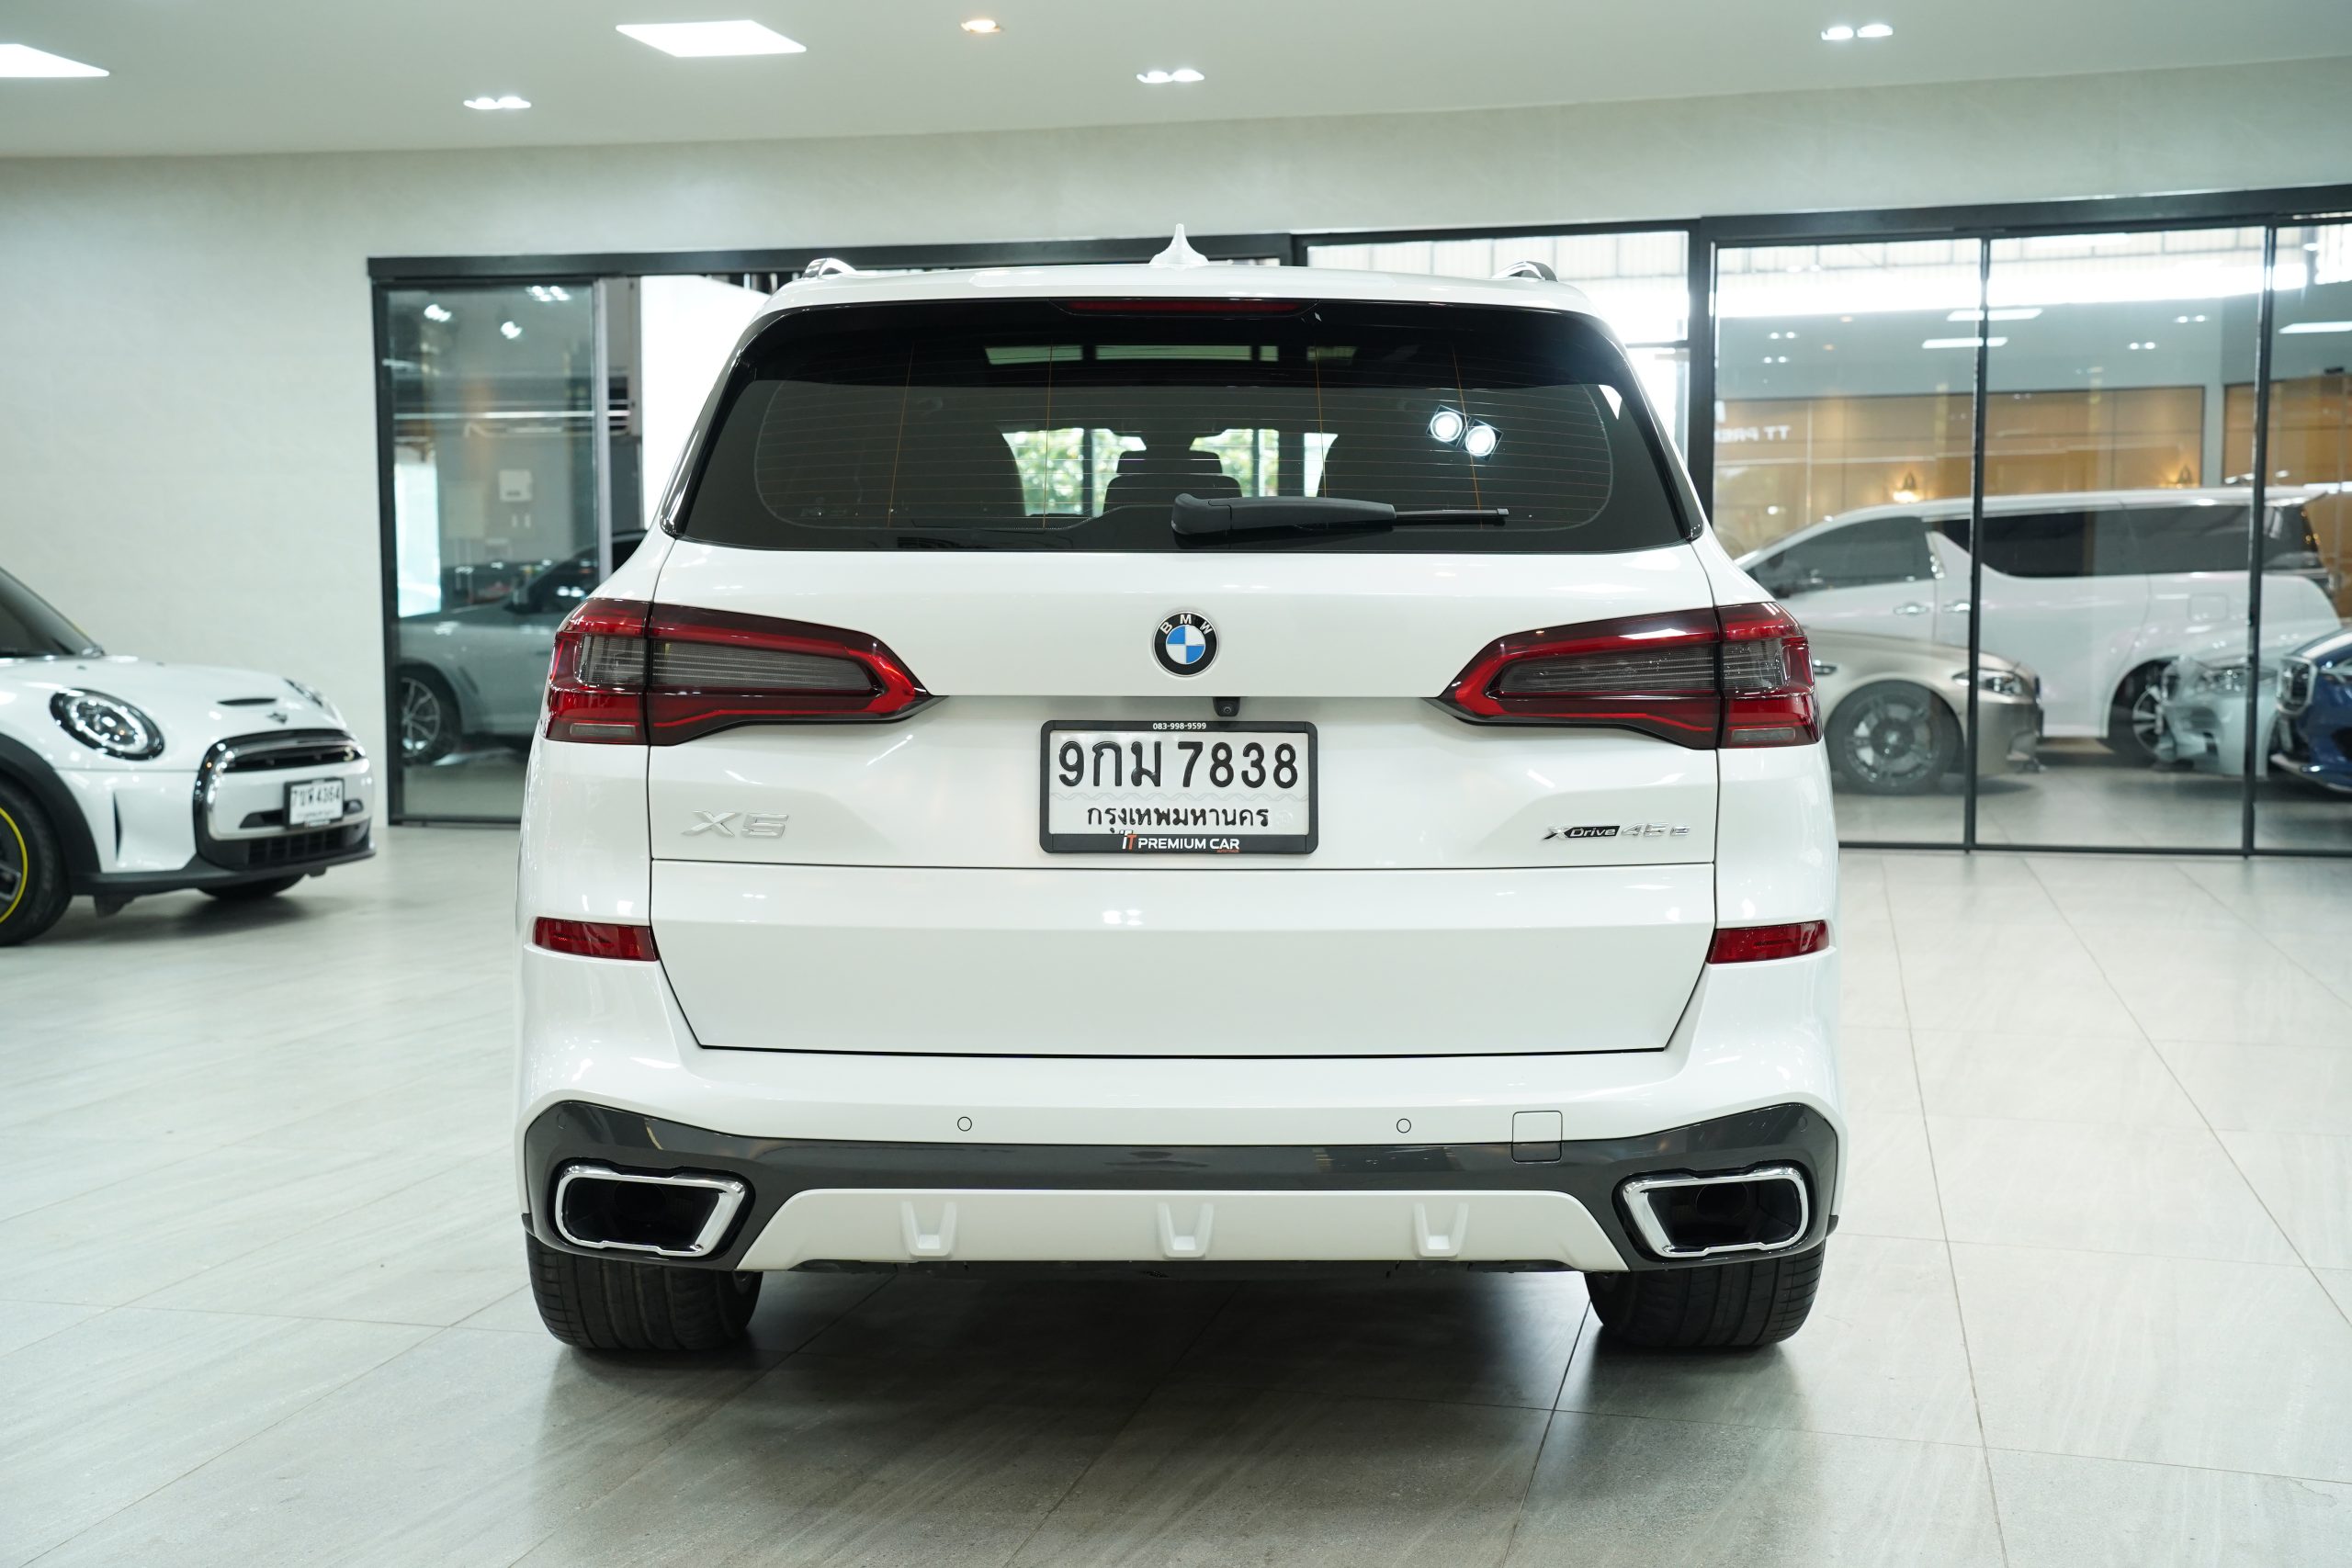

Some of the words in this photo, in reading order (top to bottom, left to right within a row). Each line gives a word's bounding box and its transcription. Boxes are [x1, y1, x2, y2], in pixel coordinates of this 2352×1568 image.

[1159, 614, 1213, 635] BMW
[1152, 722, 1206, 730] 083-998-9599
[1058, 740, 1161, 787] 9กม
[1177, 740, 1298, 788] 7838
[681, 810, 789, 839] X5
[1087, 807, 1270, 833] กรุงเทพมหานคร
[1137, 838, 1206, 850] PREMIUM
[1209, 838, 1240, 850] CAR
